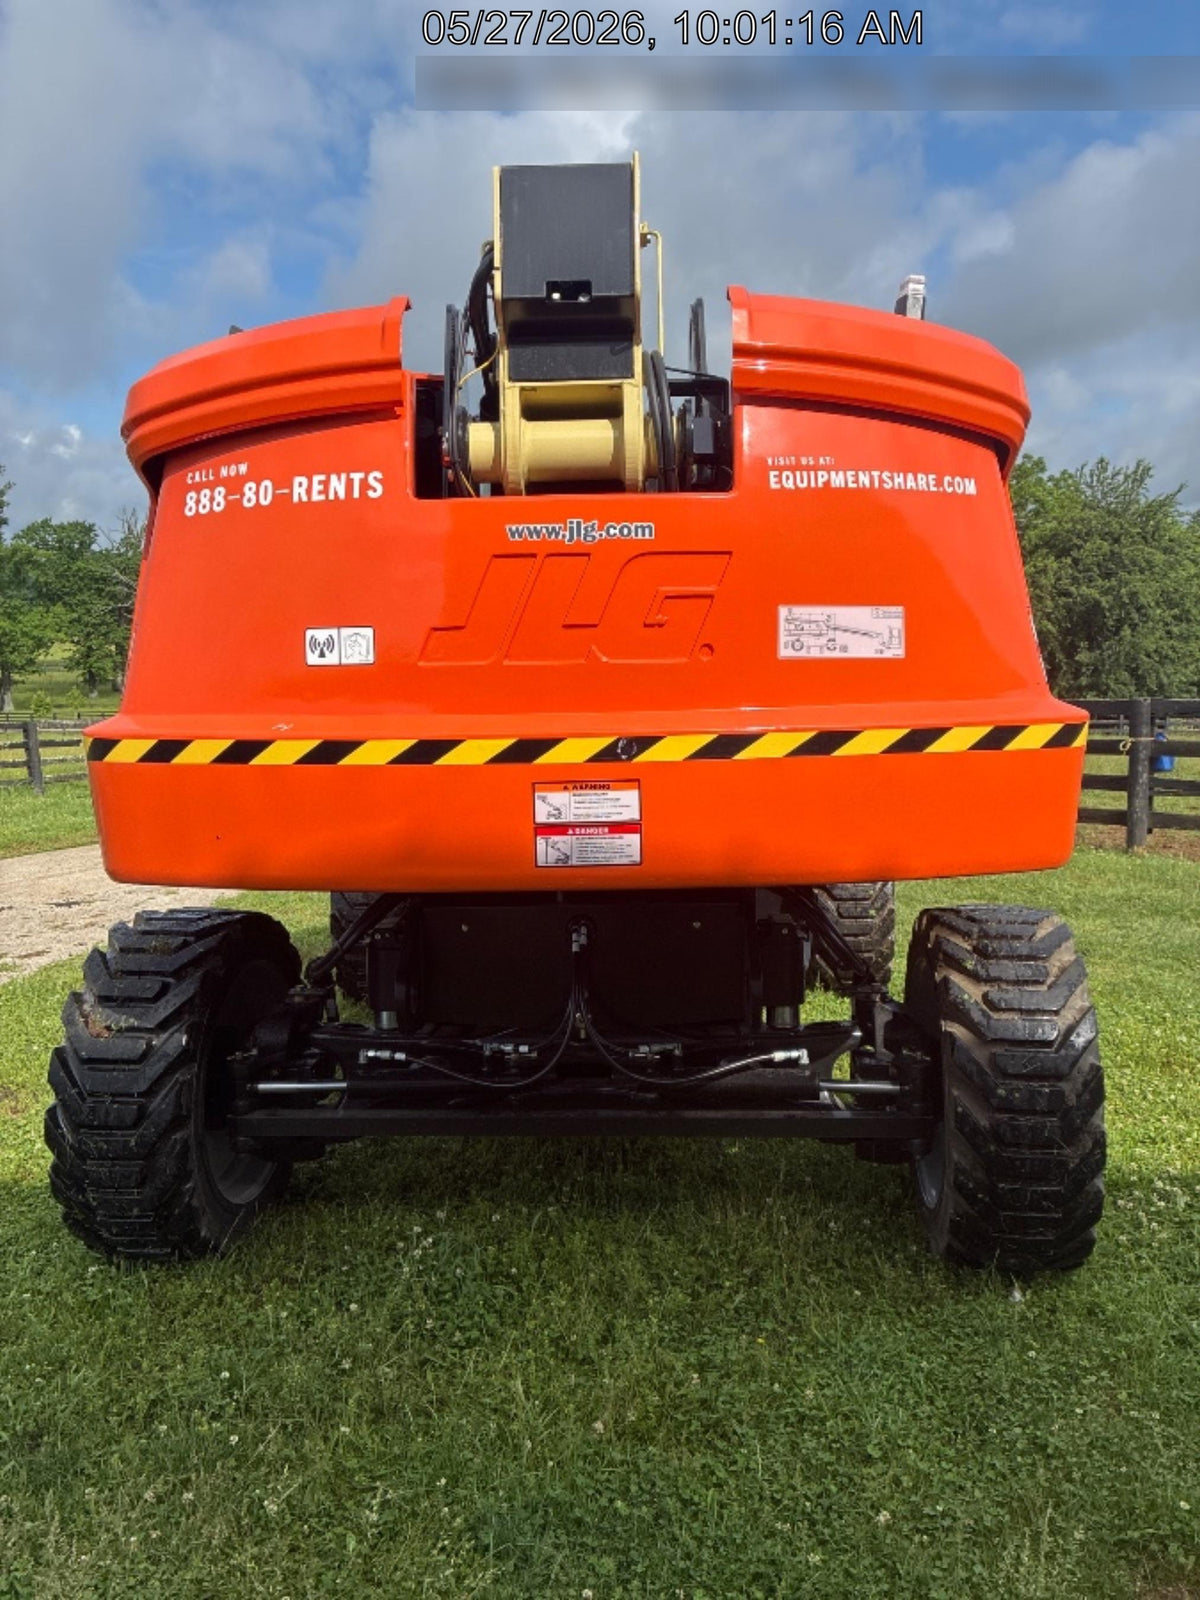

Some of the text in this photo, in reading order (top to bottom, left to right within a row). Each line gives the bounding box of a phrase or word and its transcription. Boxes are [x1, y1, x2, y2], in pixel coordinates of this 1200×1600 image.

[186, 462, 249, 485] CALL NOW
[766, 456, 796, 466] VISIT
[801, 457, 815, 466] US
[184, 471, 385, 517] 888-80-RENTS
[769, 470, 977, 495] EQUIPMENTSHARE.COM
[506, 519, 655, 544] www.jlg.com
